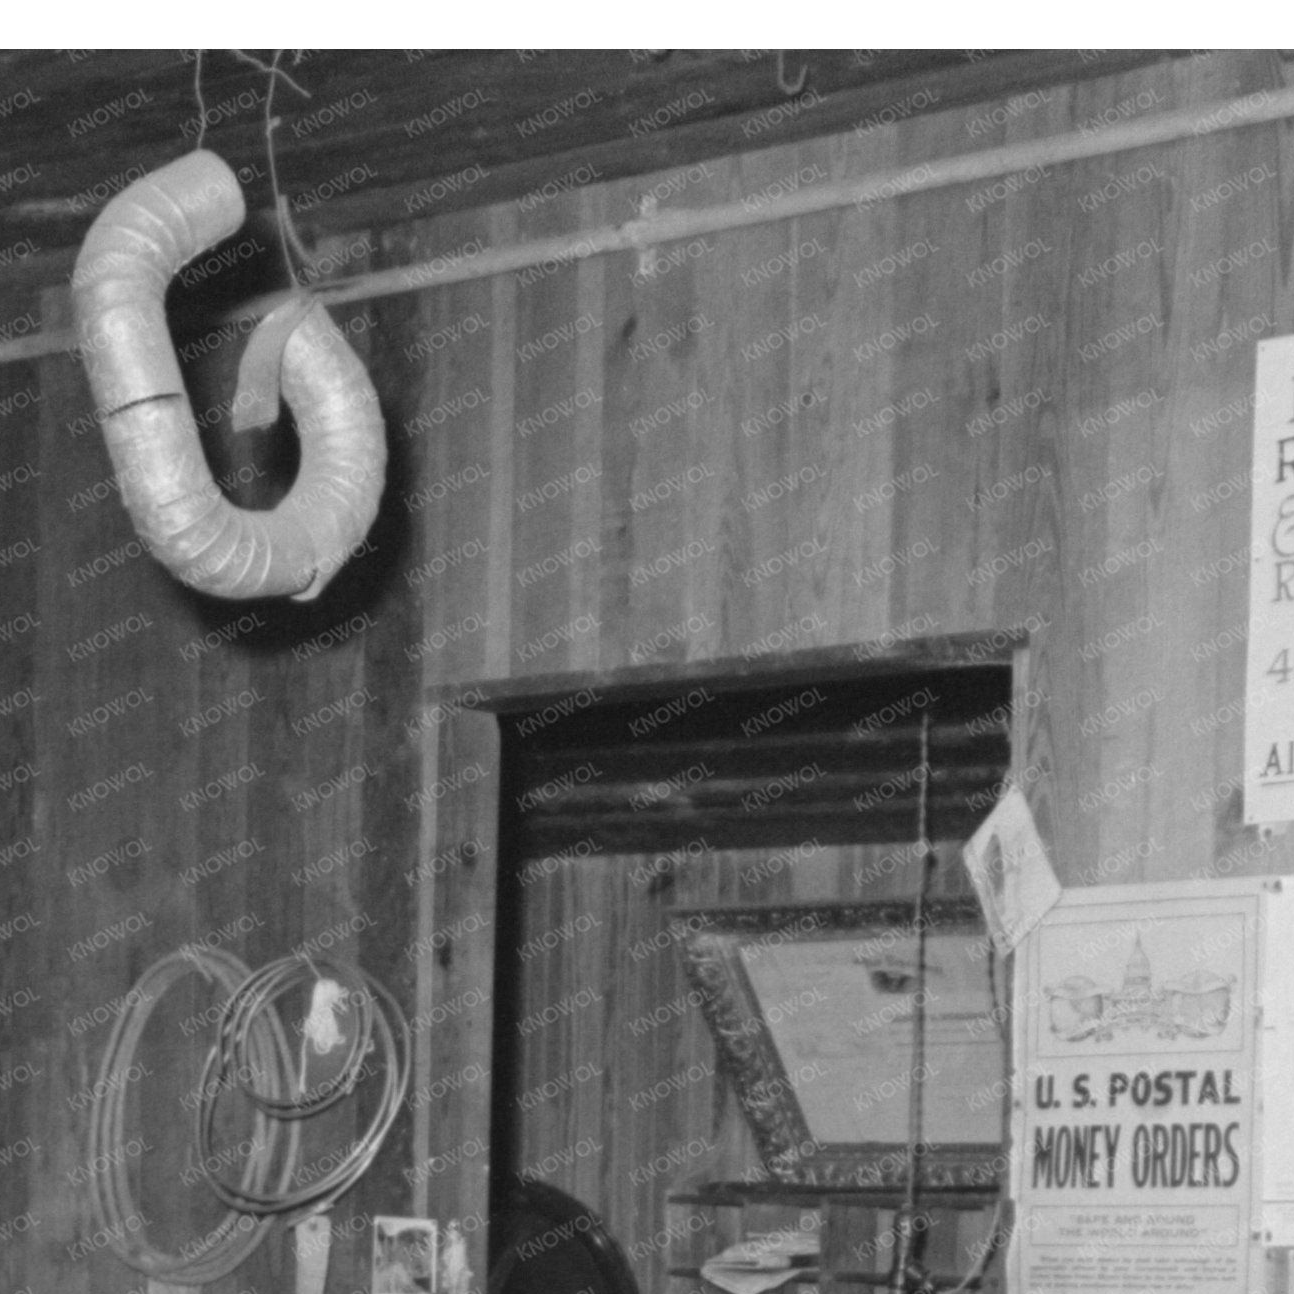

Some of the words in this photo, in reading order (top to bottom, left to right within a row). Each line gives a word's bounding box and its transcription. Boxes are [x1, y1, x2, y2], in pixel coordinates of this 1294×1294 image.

[1035, 1074, 1061, 1109] U.
[1072, 1073, 1098, 1109] S.
[1108, 1069, 1242, 1108] POSTAL
[1031, 1123, 1122, 1189] MONEY
[1132, 1122, 1241, 1188] ORDERS
